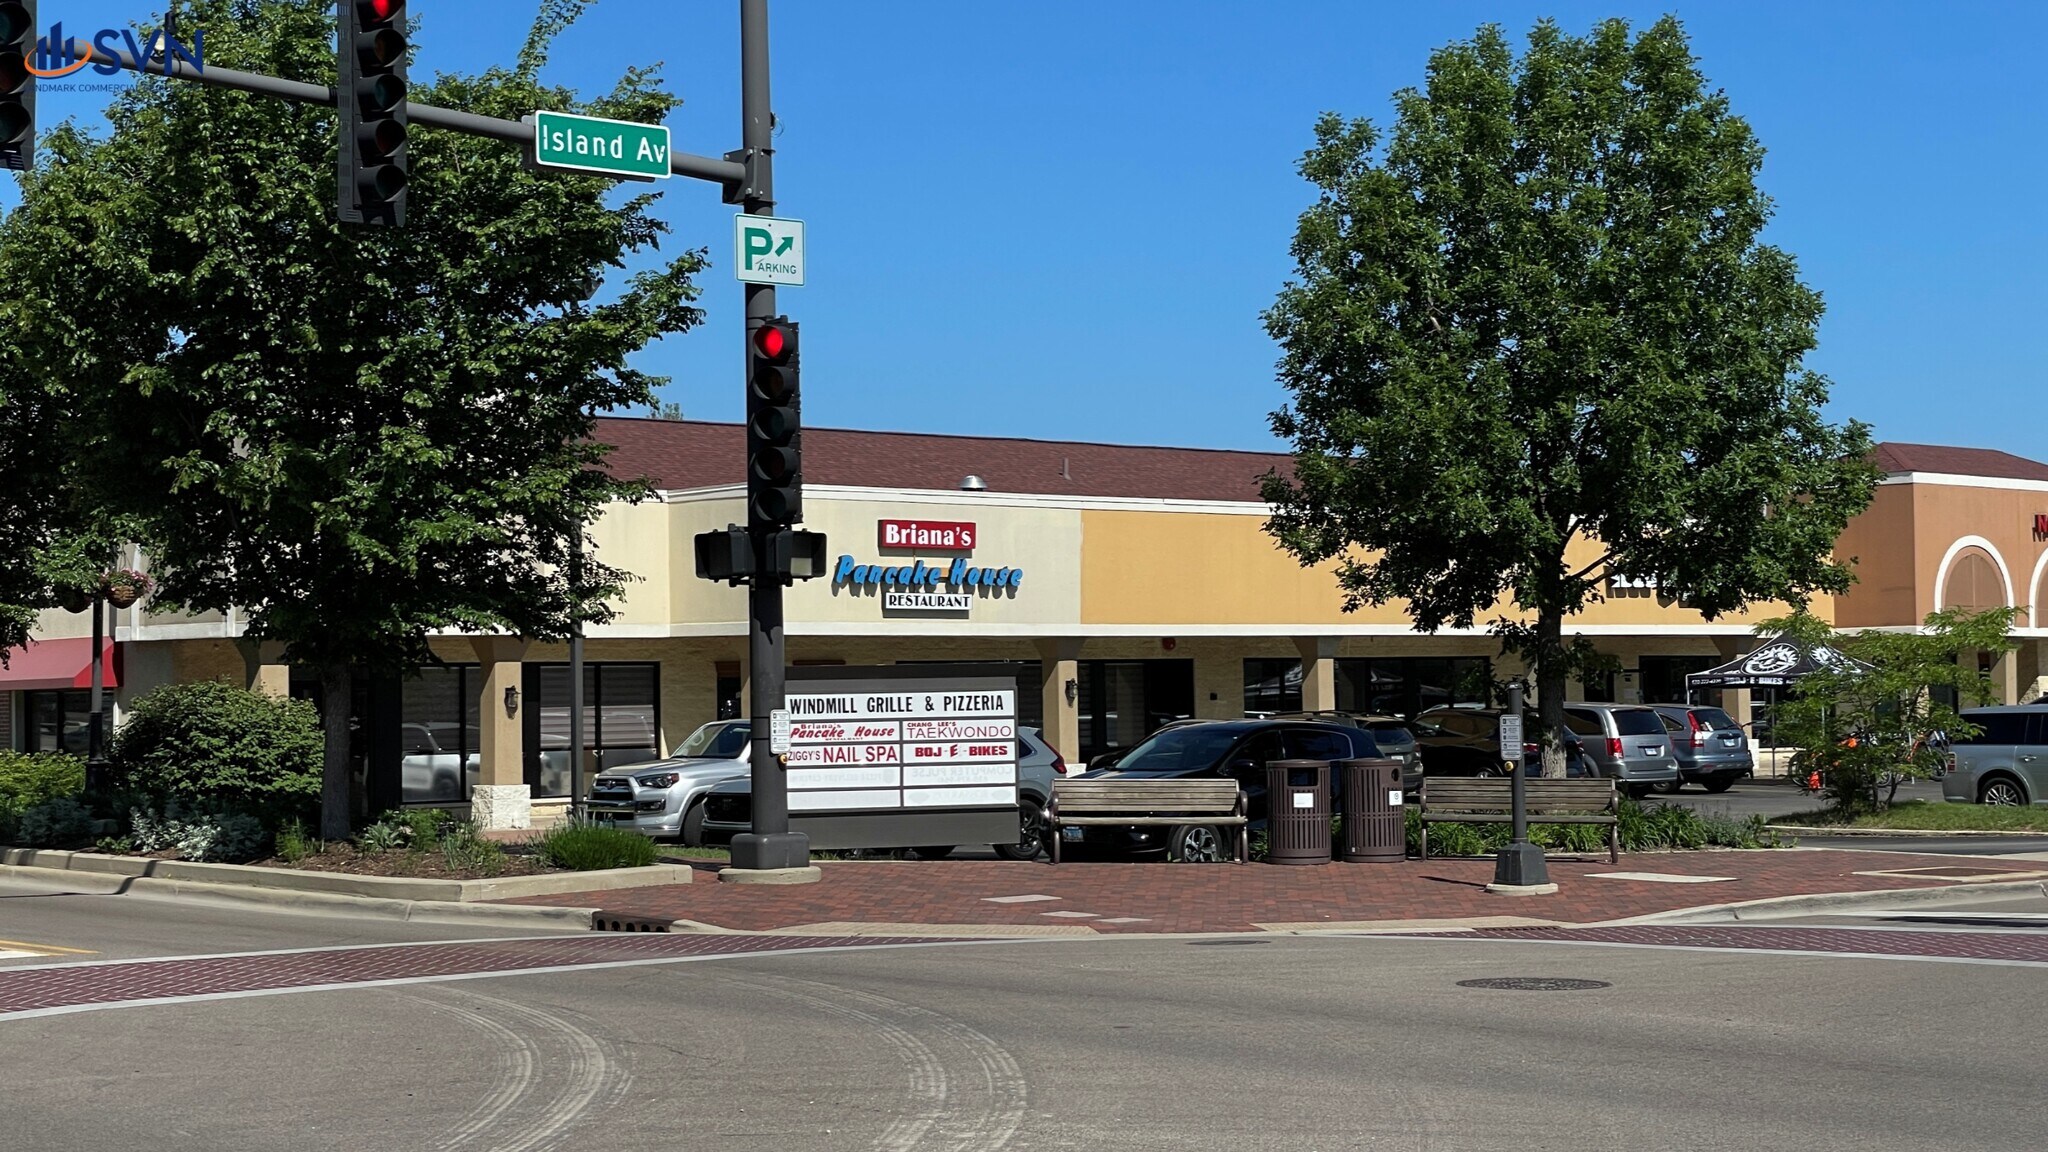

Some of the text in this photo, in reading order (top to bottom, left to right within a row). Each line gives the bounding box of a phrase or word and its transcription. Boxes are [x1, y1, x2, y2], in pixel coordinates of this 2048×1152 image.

[542, 124, 666, 163] Island Av
[885, 523, 972, 547] Briana's
[834, 555, 1024, 587] Pancake House
[888, 594, 971, 608] RESTAURANT
[789, 694, 1004, 715] WINDMILL GRILLE & PIZZERIA
[790, 727, 845, 739] Pancake
[854, 726, 895, 737] House
[907, 726, 1012, 739] TAEKWONDO
[788, 745, 898, 763] ZIGGY'S NAIL SPA
